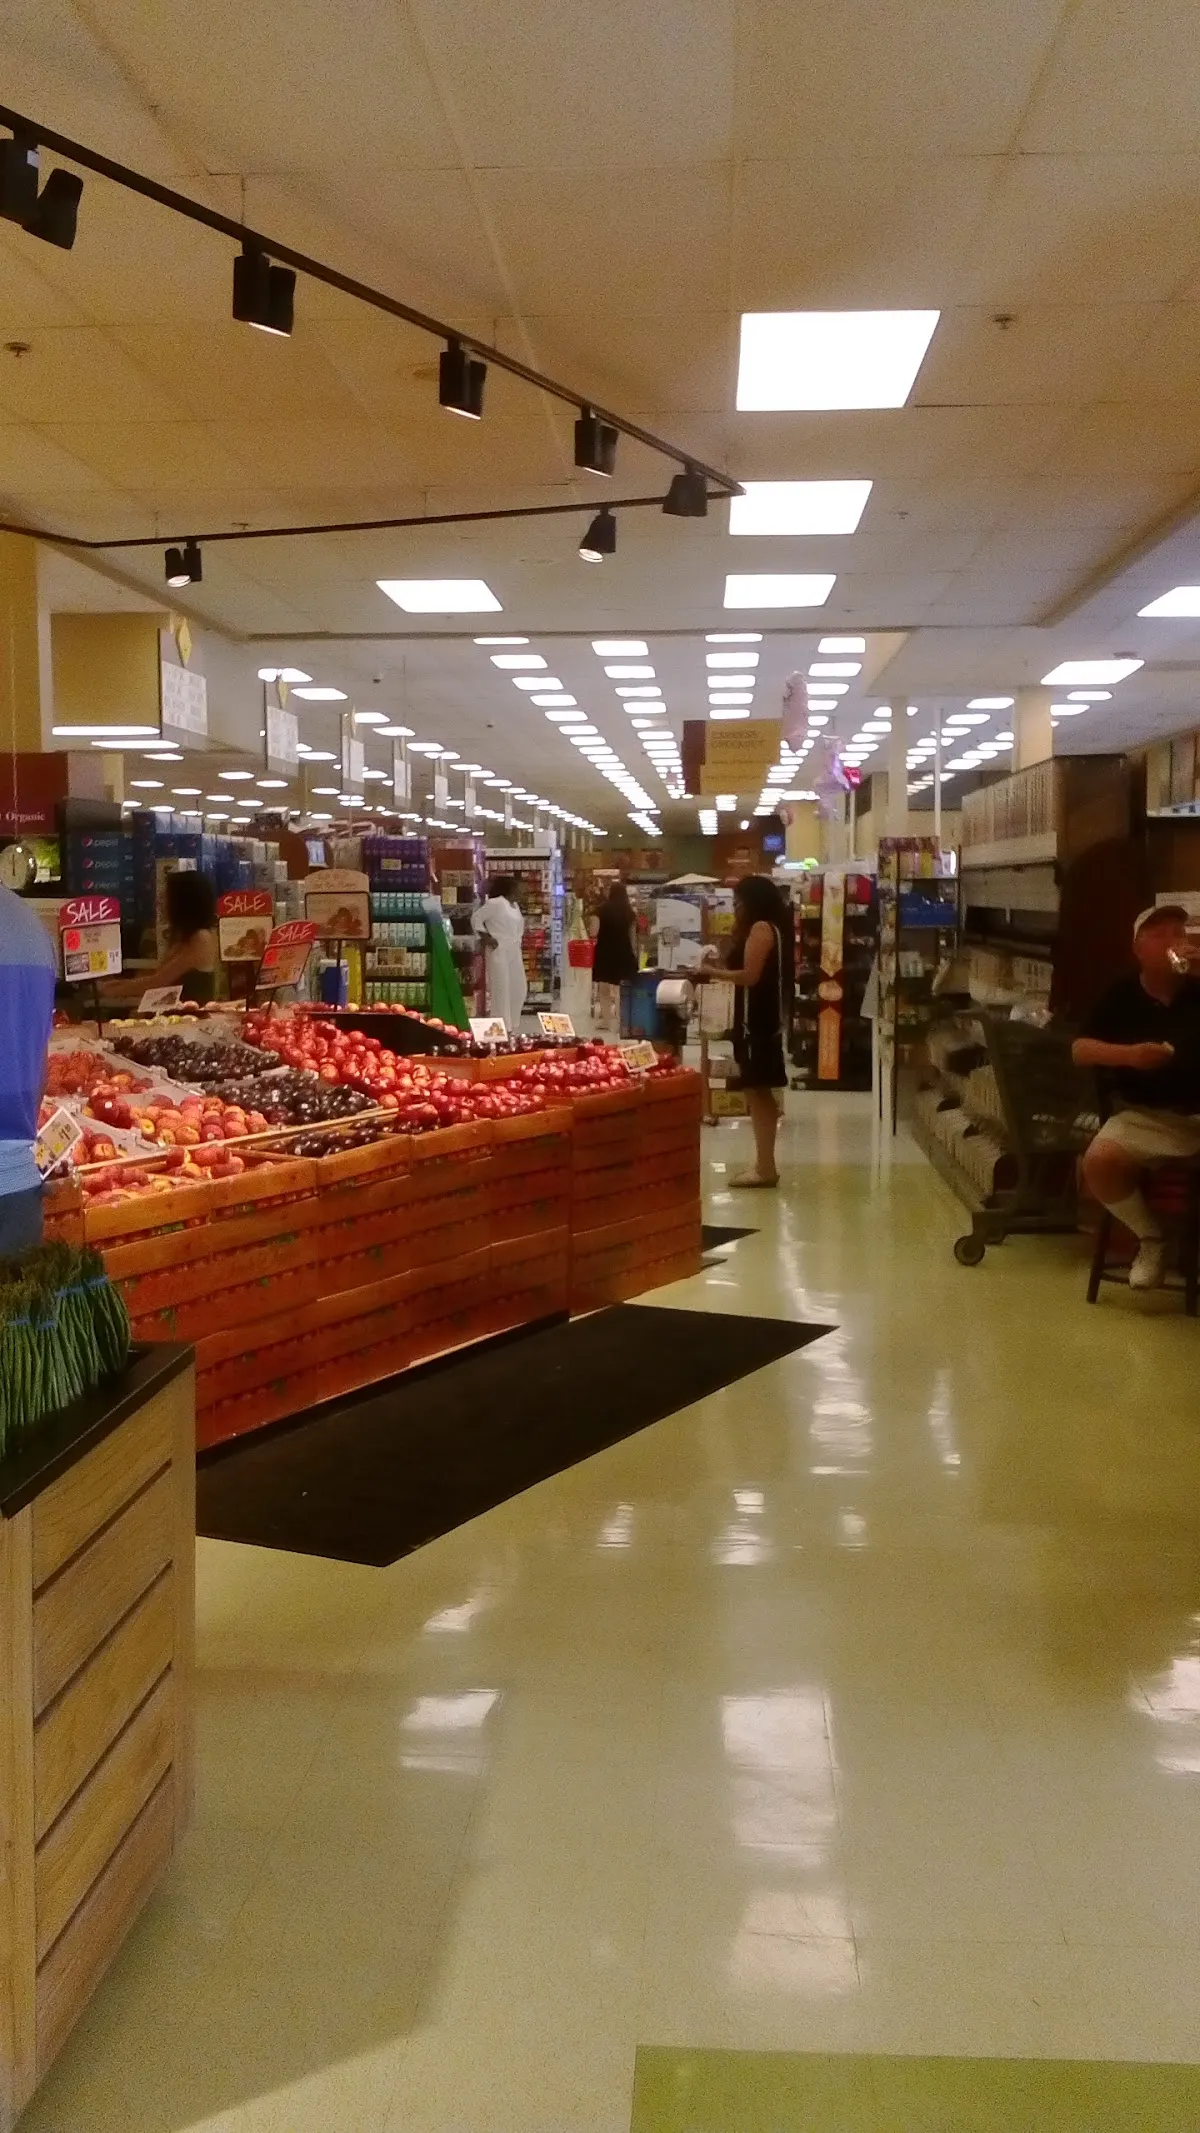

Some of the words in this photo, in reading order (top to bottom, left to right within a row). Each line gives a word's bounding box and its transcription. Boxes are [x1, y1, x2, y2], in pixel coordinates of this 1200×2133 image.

[5, 811, 45, 823] Organic
[94, 839, 119, 847] pepsi
[67, 898, 113, 924] SALE
[222, 892, 266, 914] SALE
[276, 922, 313, 943] SALE
